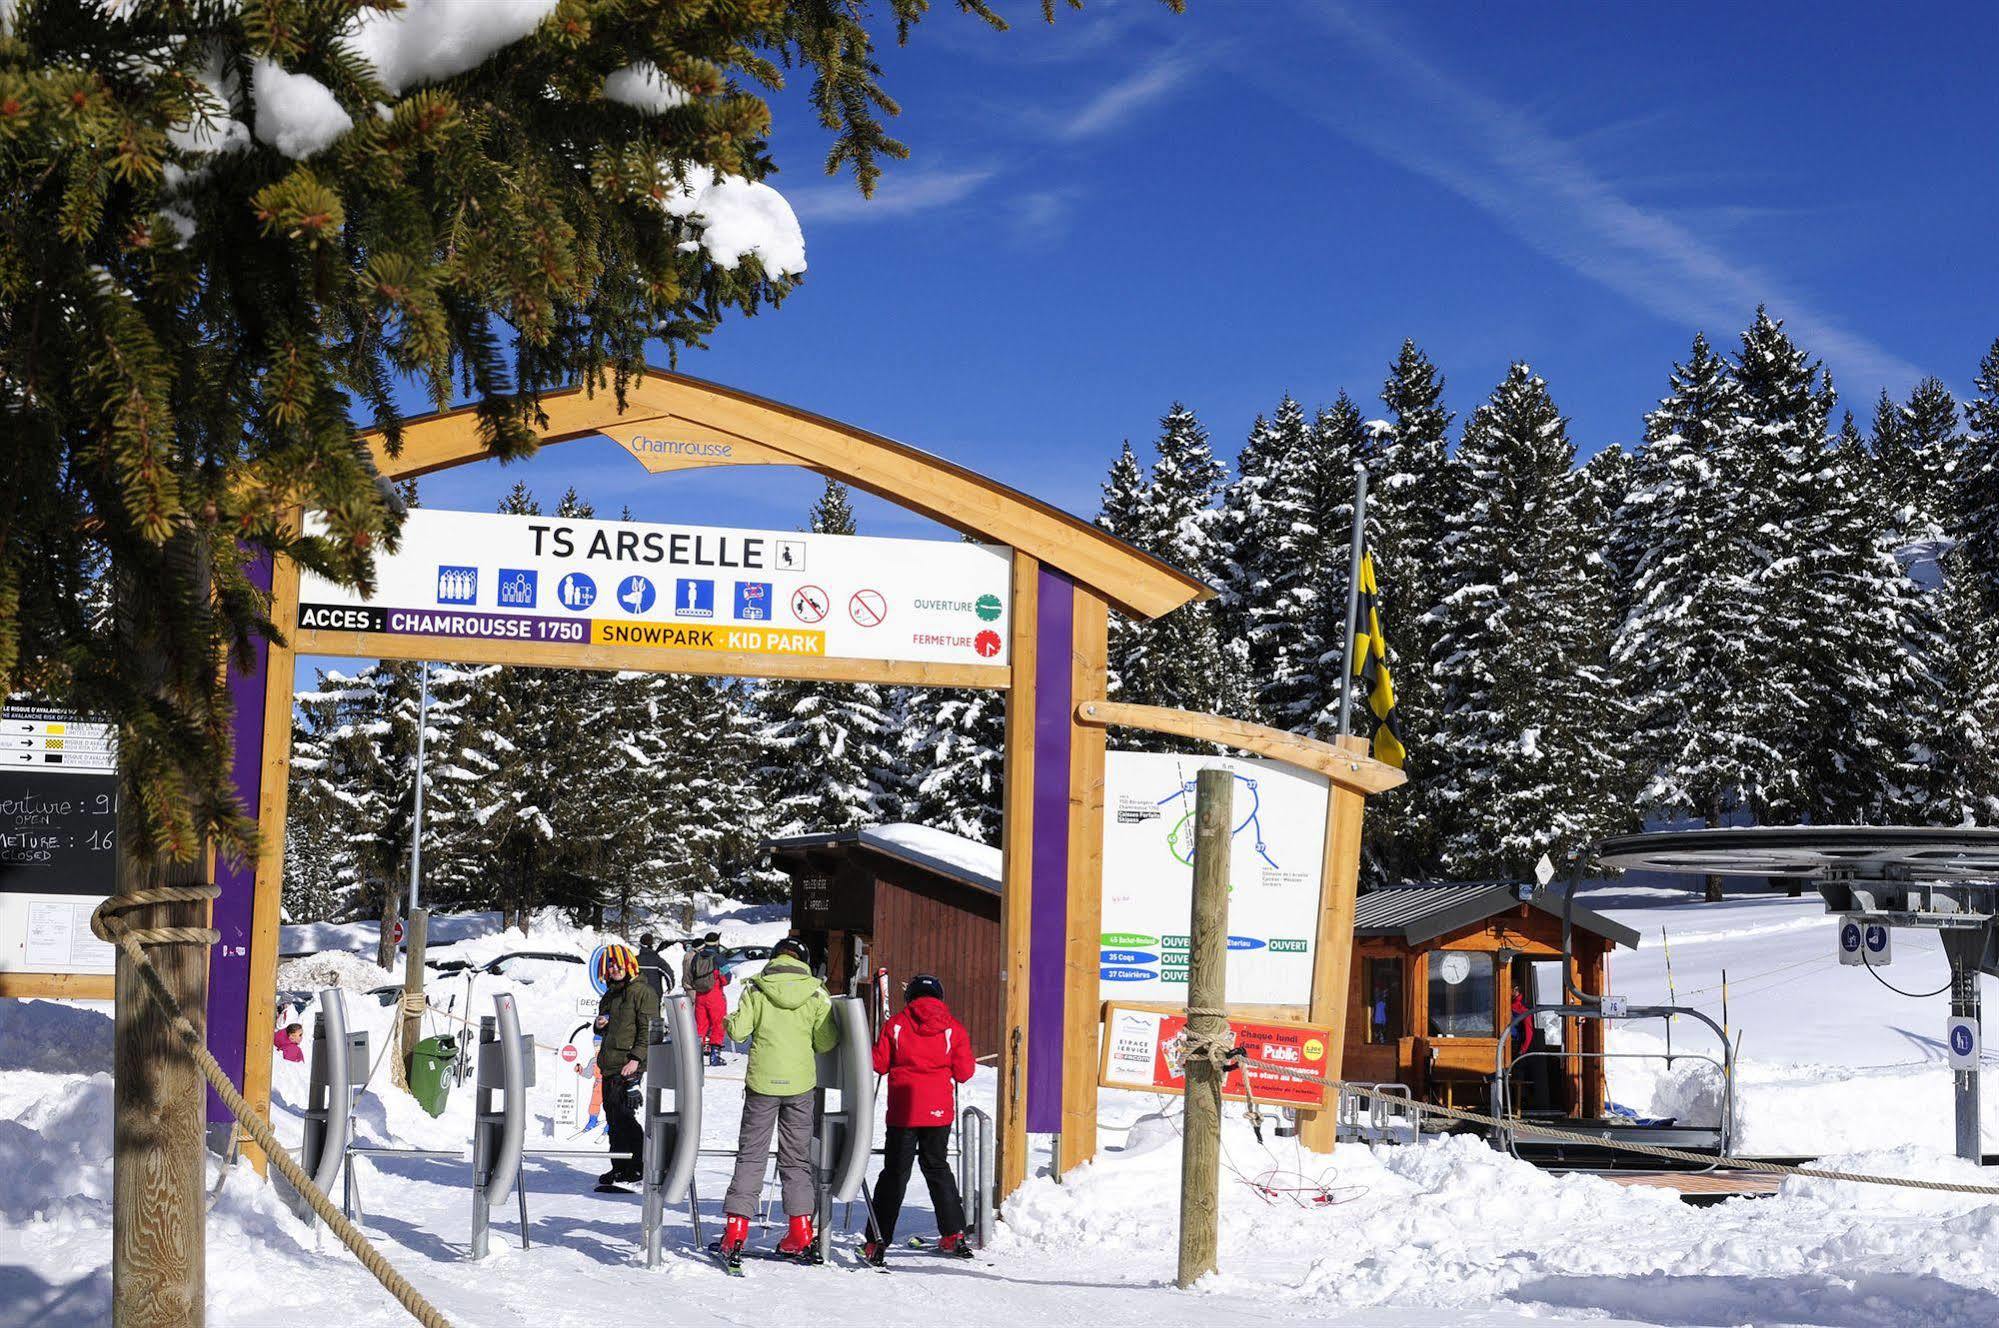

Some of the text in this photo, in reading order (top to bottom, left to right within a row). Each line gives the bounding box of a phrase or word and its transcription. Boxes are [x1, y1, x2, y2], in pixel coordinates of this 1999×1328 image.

[631, 435, 733, 457] Chamrousse
[528, 525, 764, 569] TS ARSELLE
[913, 599, 973, 613] OUVERTURE
[301, 607, 369, 629] ACCES
[391, 614, 531, 638] CHAMROUSSE
[538, 621, 583, 640] 1750
[602, 625, 714, 647] SNOWPARK
[727, 632, 763, 650] KID
[766, 633, 819, 652] PARK
[912, 634, 972, 648] FERMETURE
[31, 707, 68, 715] D'AVALANC
[0, 788, 72, 815] erture
[15, 814, 50, 825] OPEN
[1, 850, 52, 862] CLOSED
[1162, 937, 1191, 947] OUVE
[1270, 940, 1306, 951] OUVERT
[1162, 954, 1190, 964] OUVE
[1162, 971, 1189, 981] OUVE
[1240, 1029, 1298, 1043] Chaque lundi
[1240, 1040, 1299, 1062] dans Public
